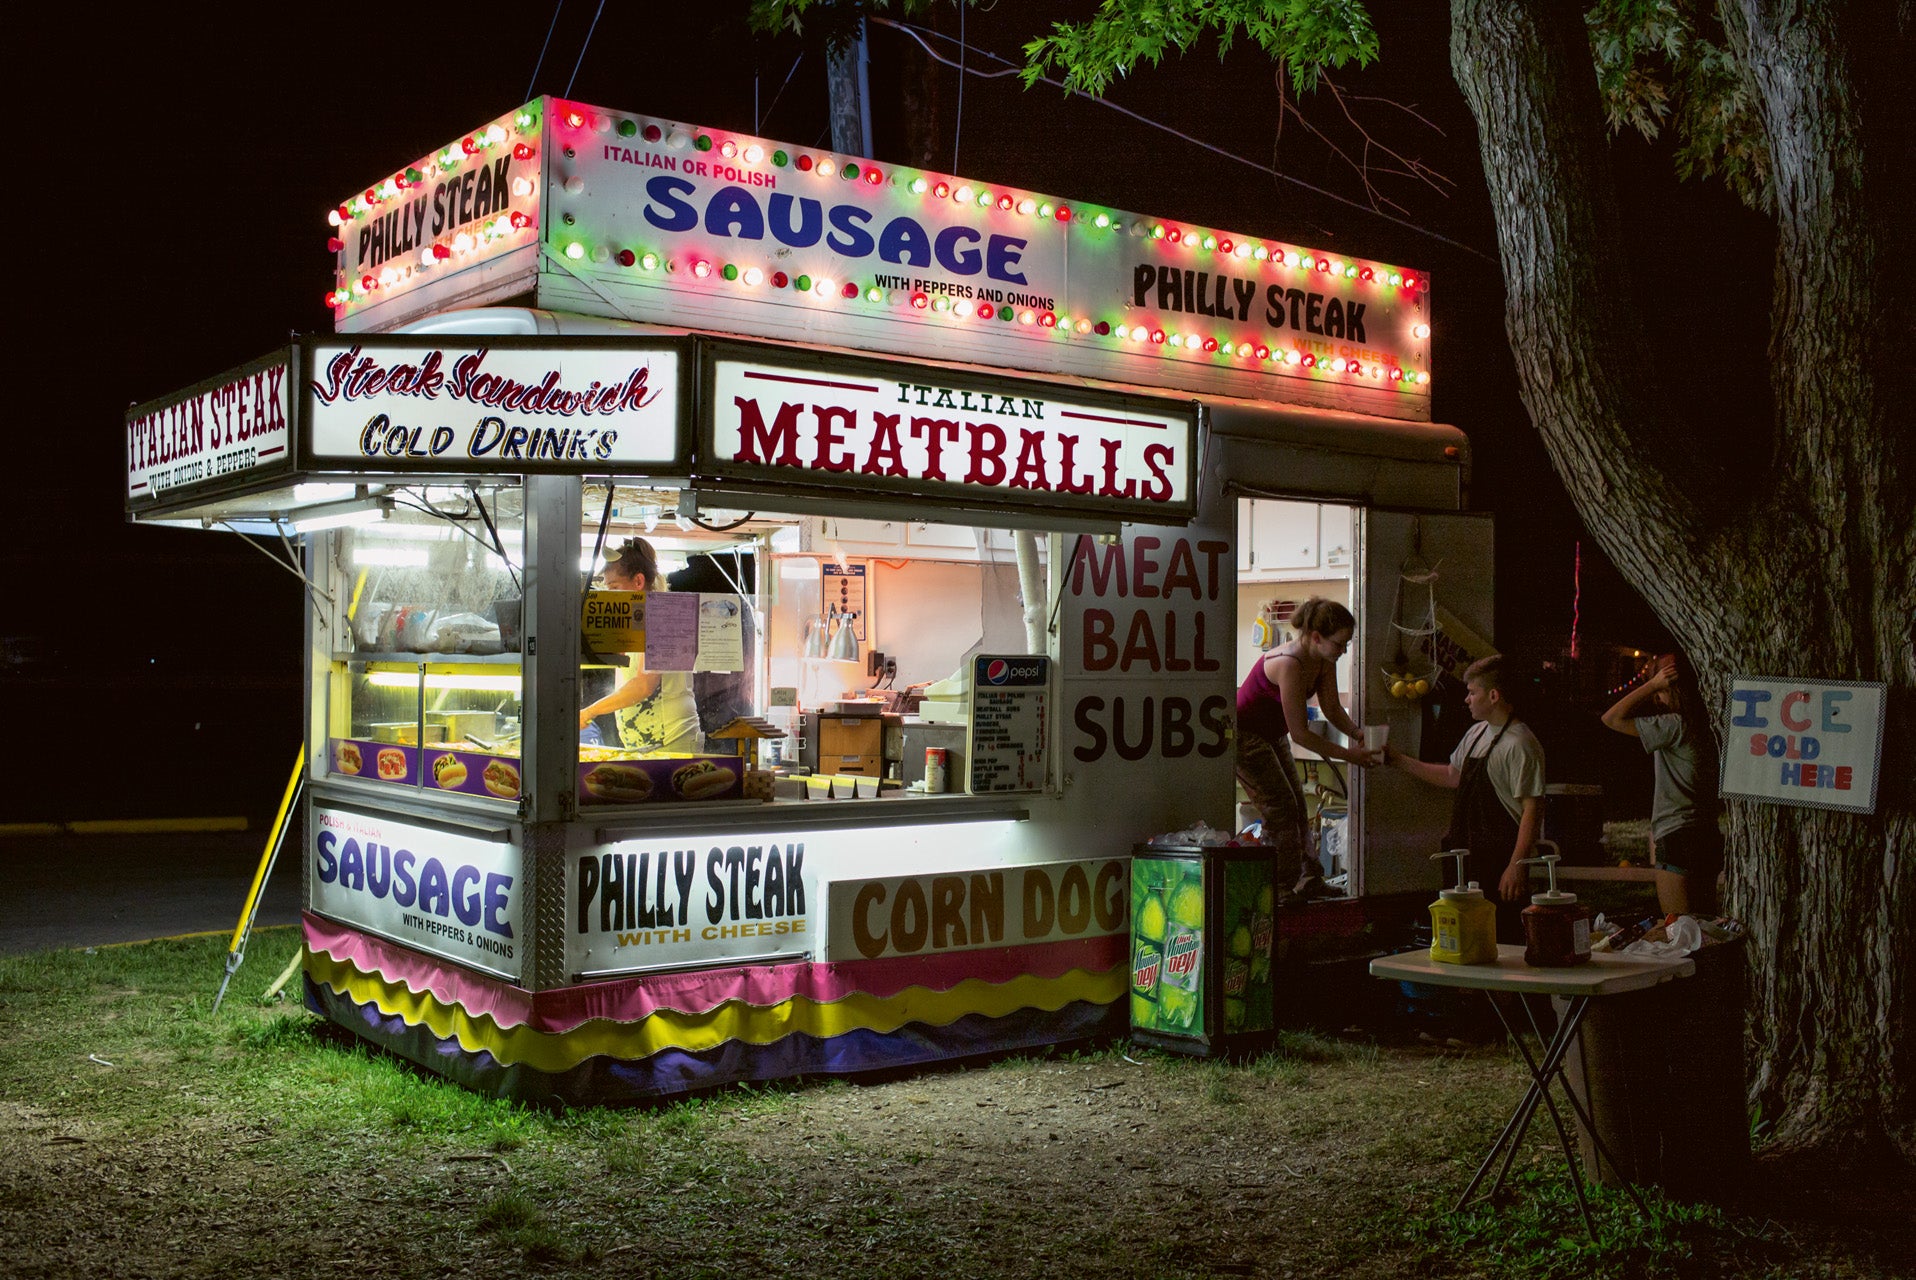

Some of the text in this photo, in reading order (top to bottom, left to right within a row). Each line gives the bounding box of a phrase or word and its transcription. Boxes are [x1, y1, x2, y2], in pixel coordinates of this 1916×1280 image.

[604, 145, 776, 189] ITALIAN OR POLISH
[358, 153, 511, 268] PHILLY STEAK
[643, 175, 1028, 286] SAUSAGE
[875, 273, 1055, 311] WITH PEPPERS AND ONIONS
[1134, 264, 1366, 344] PHILLY STEAK
[1293, 337, 1399, 367] WITH CHEESE
[309, 344, 663, 417] Steak Sandwich
[898, 383, 1044, 420] ITALIAN
[129, 363, 286, 473] ITALIAN STEAK
[360, 413, 620, 461] COLD DRINKS
[149, 447, 256, 490] WITH ONIONS & PEPPERS
[733, 396, 1175, 502] MEATBALLS
[1072, 534, 1229, 601] MEAT
[586, 616, 632, 629] PERMIT
[588, 602, 630, 615] STAND
[1083, 608, 1220, 673] BALL
[1010, 665, 1039, 679] pepsi
[1073, 695, 1230, 762] SUBS
[1731, 689, 1853, 733] ICE
[1750, 733, 1820, 760] SOLD
[1781, 762, 1853, 790] HERE
[319, 813, 345, 829] POLISH
[316, 830, 514, 939] SAUSAGE
[578, 843, 806, 934] PHILLY STEAK
[616, 919, 807, 947] WITH CHEESE
[852, 859, 1131, 960] CORN DOG
[402, 912, 514, 959] WITH PEPPERS & ONIONS
